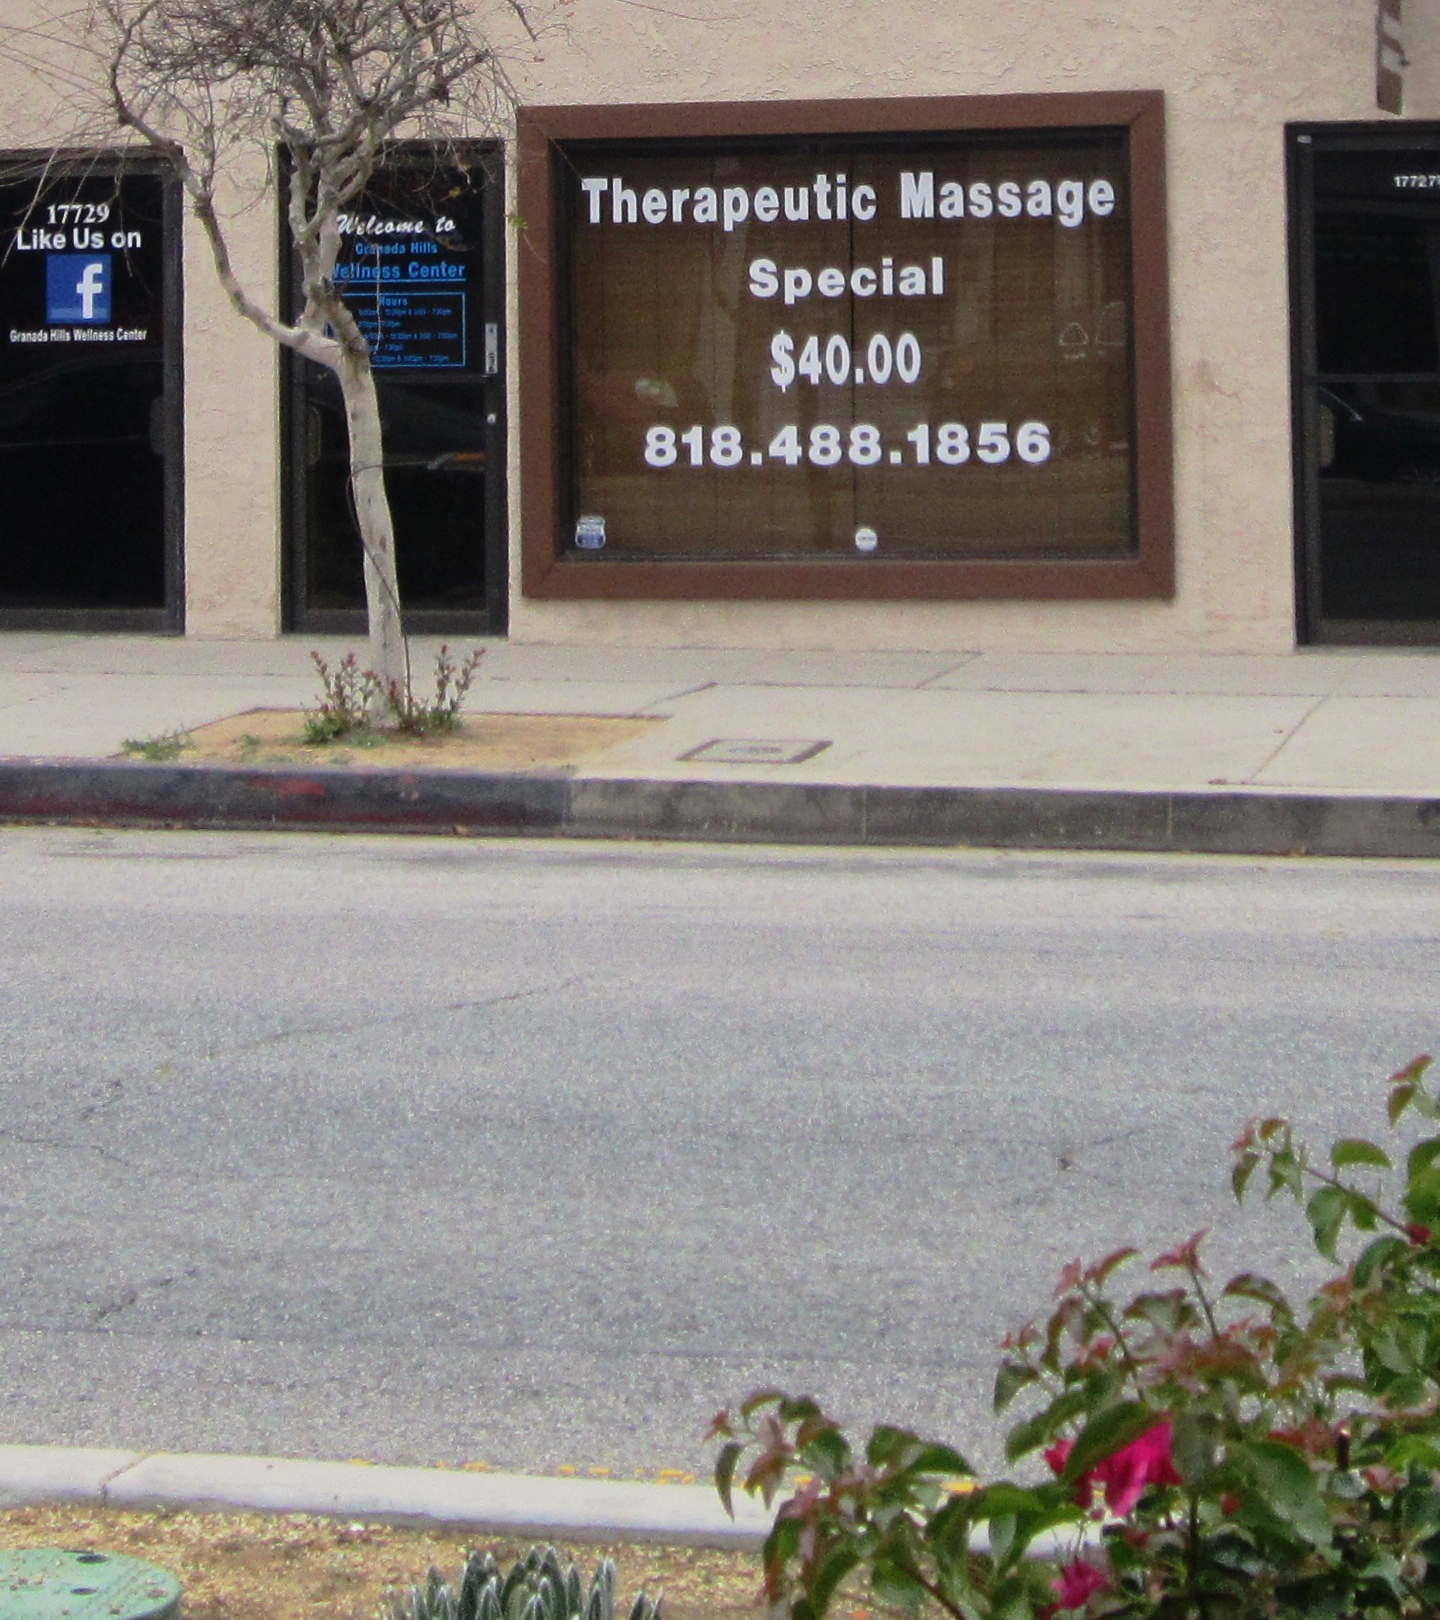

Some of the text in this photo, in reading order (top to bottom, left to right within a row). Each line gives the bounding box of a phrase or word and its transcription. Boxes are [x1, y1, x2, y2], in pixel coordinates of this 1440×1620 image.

[581, 171, 1116, 231] Therapeutic Massage
[47, 203, 110, 225] 17729
[337, 214, 456, 235] Welcome to
[16, 227, 142, 250] Like Us on
[355, 241, 438, 255] Granada Hills
[408, 261, 465, 278] Center
[749, 257, 945, 304] Special
[9, 327, 147, 343] Granada Hills Wellness Center
[770, 330, 922, 391] $40.00
[644, 422, 1052, 467] 818.488.1856
